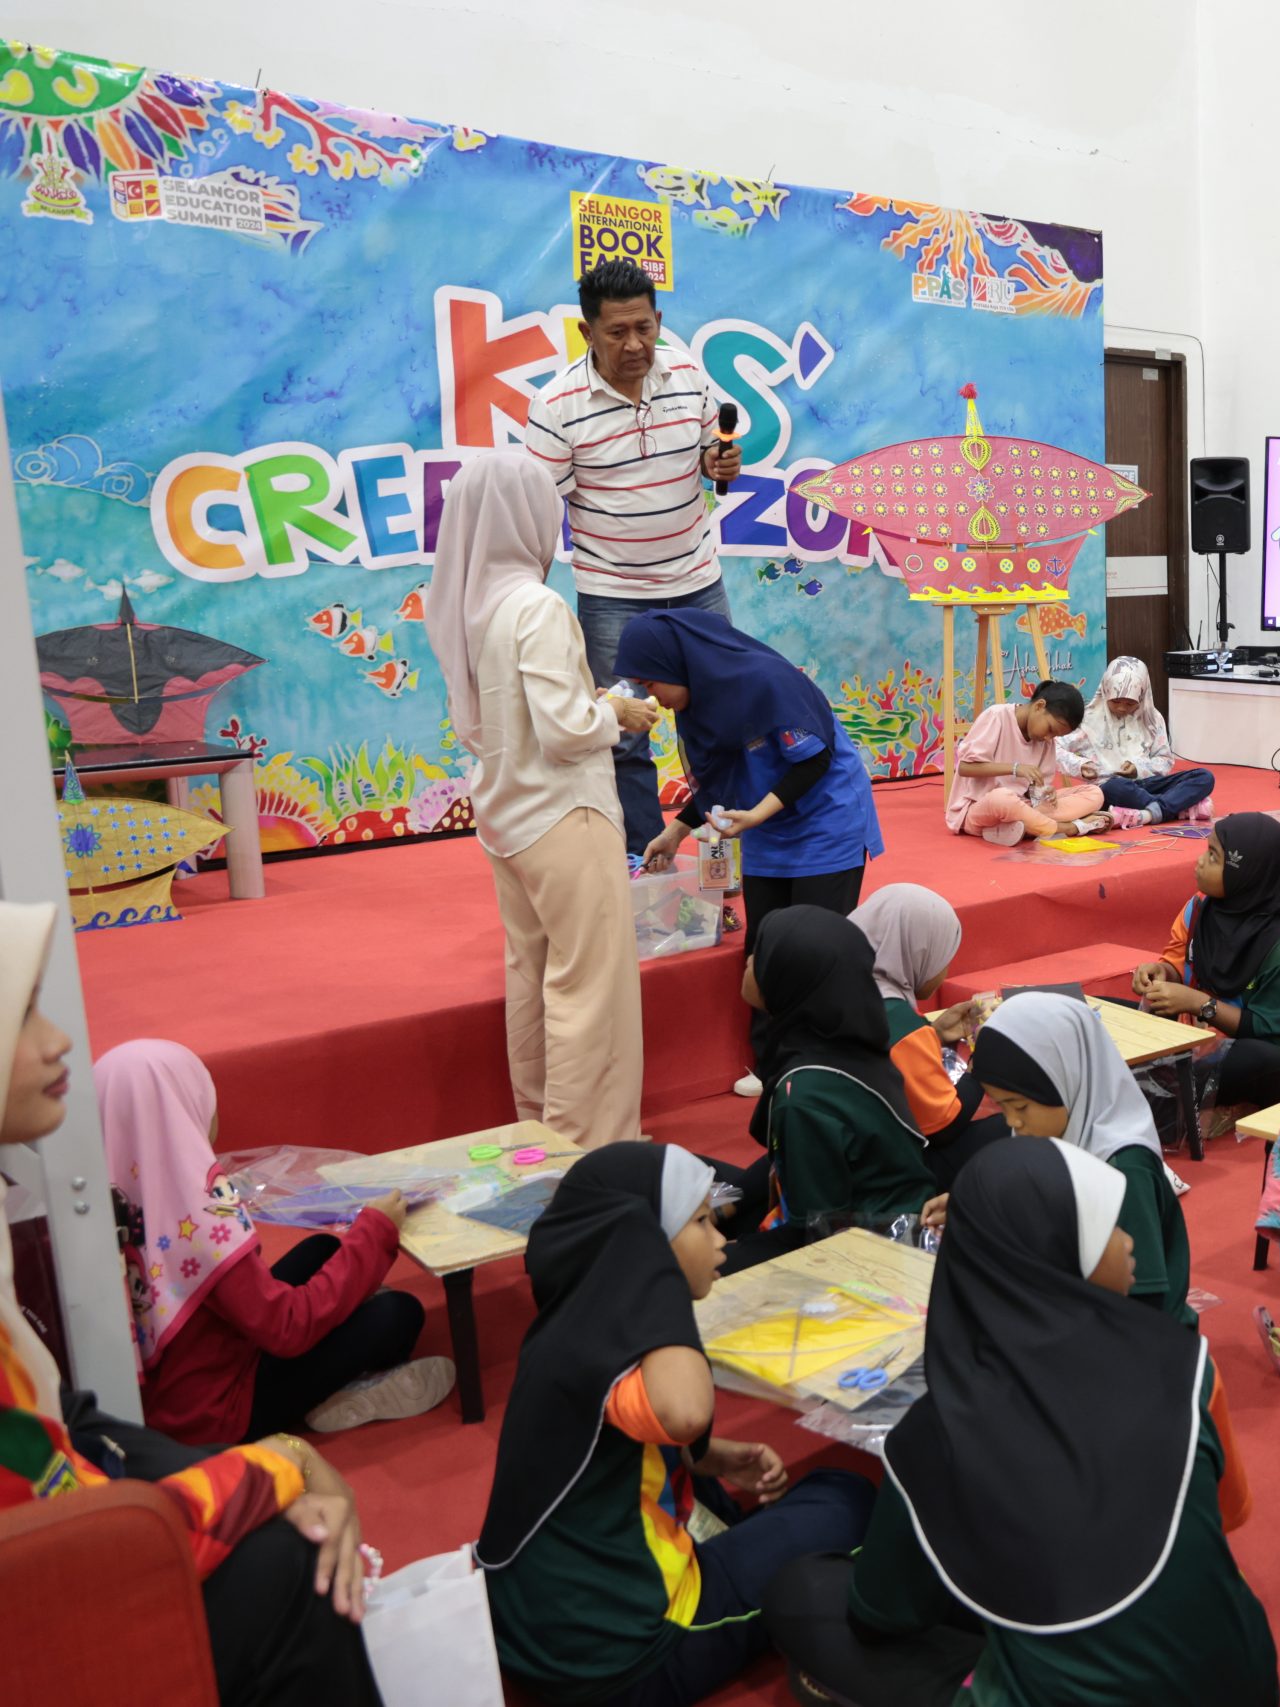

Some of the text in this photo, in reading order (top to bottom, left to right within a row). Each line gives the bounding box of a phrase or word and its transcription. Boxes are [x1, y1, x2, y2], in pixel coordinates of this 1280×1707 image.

[163, 179, 260, 203] SELANGOR
[165, 195, 261, 217] EDUCATION
[579, 199, 662, 223] SELANGOR
[167, 209, 262, 231] SUMMIT 2024
[580, 213, 663, 234] INTERNATIONAL
[580, 224, 664, 258] BOOK
[642, 261, 665, 272] SIBF
[645, 272, 665, 281] 024
[913, 270, 964, 301] PPAS
